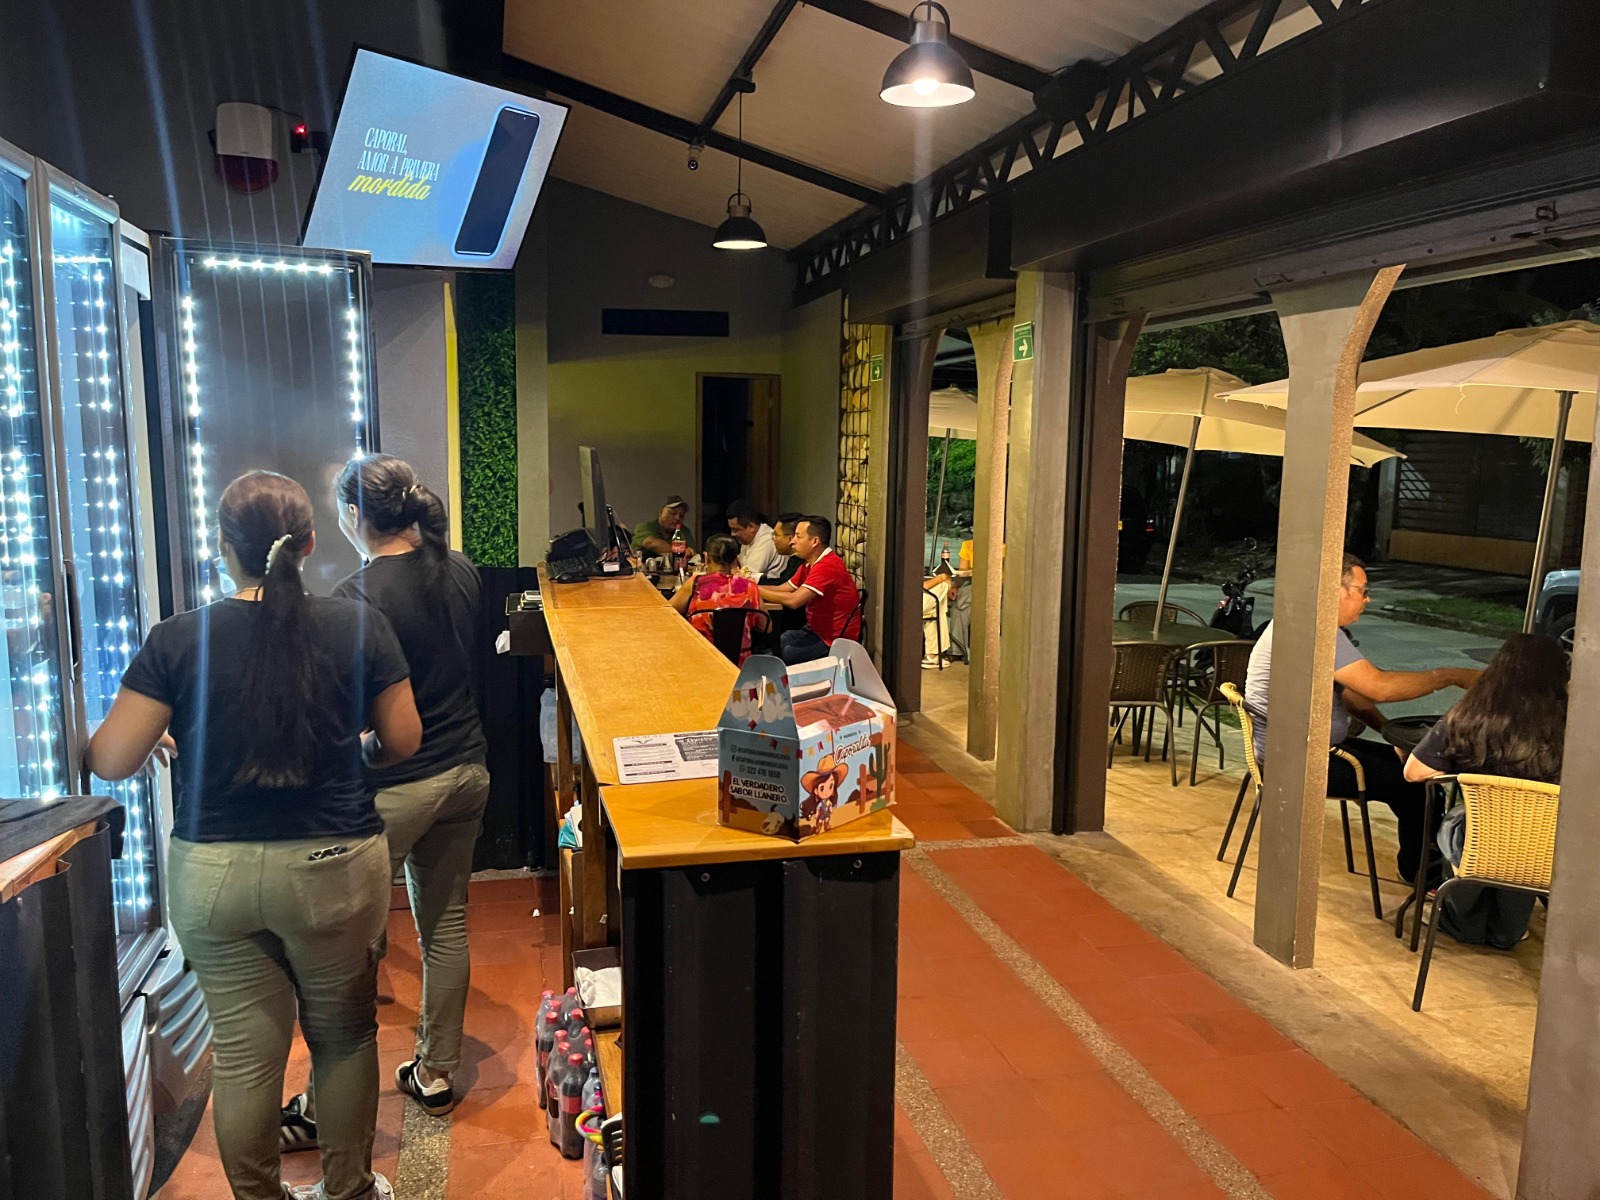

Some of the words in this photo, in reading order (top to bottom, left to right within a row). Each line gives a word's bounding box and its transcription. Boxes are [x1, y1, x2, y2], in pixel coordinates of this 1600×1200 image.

[364, 127, 408, 155] CAPORAL,
[357, 150, 389, 173] AMOR
[389, 156, 398, 175] A
[398, 157, 440, 182] PRIMERA
[347, 171, 432, 201] mordida
[730, 786, 752, 797] SABOR
[733, 777, 740, 785] EL
[741, 779, 784, 793] VERDADERO
